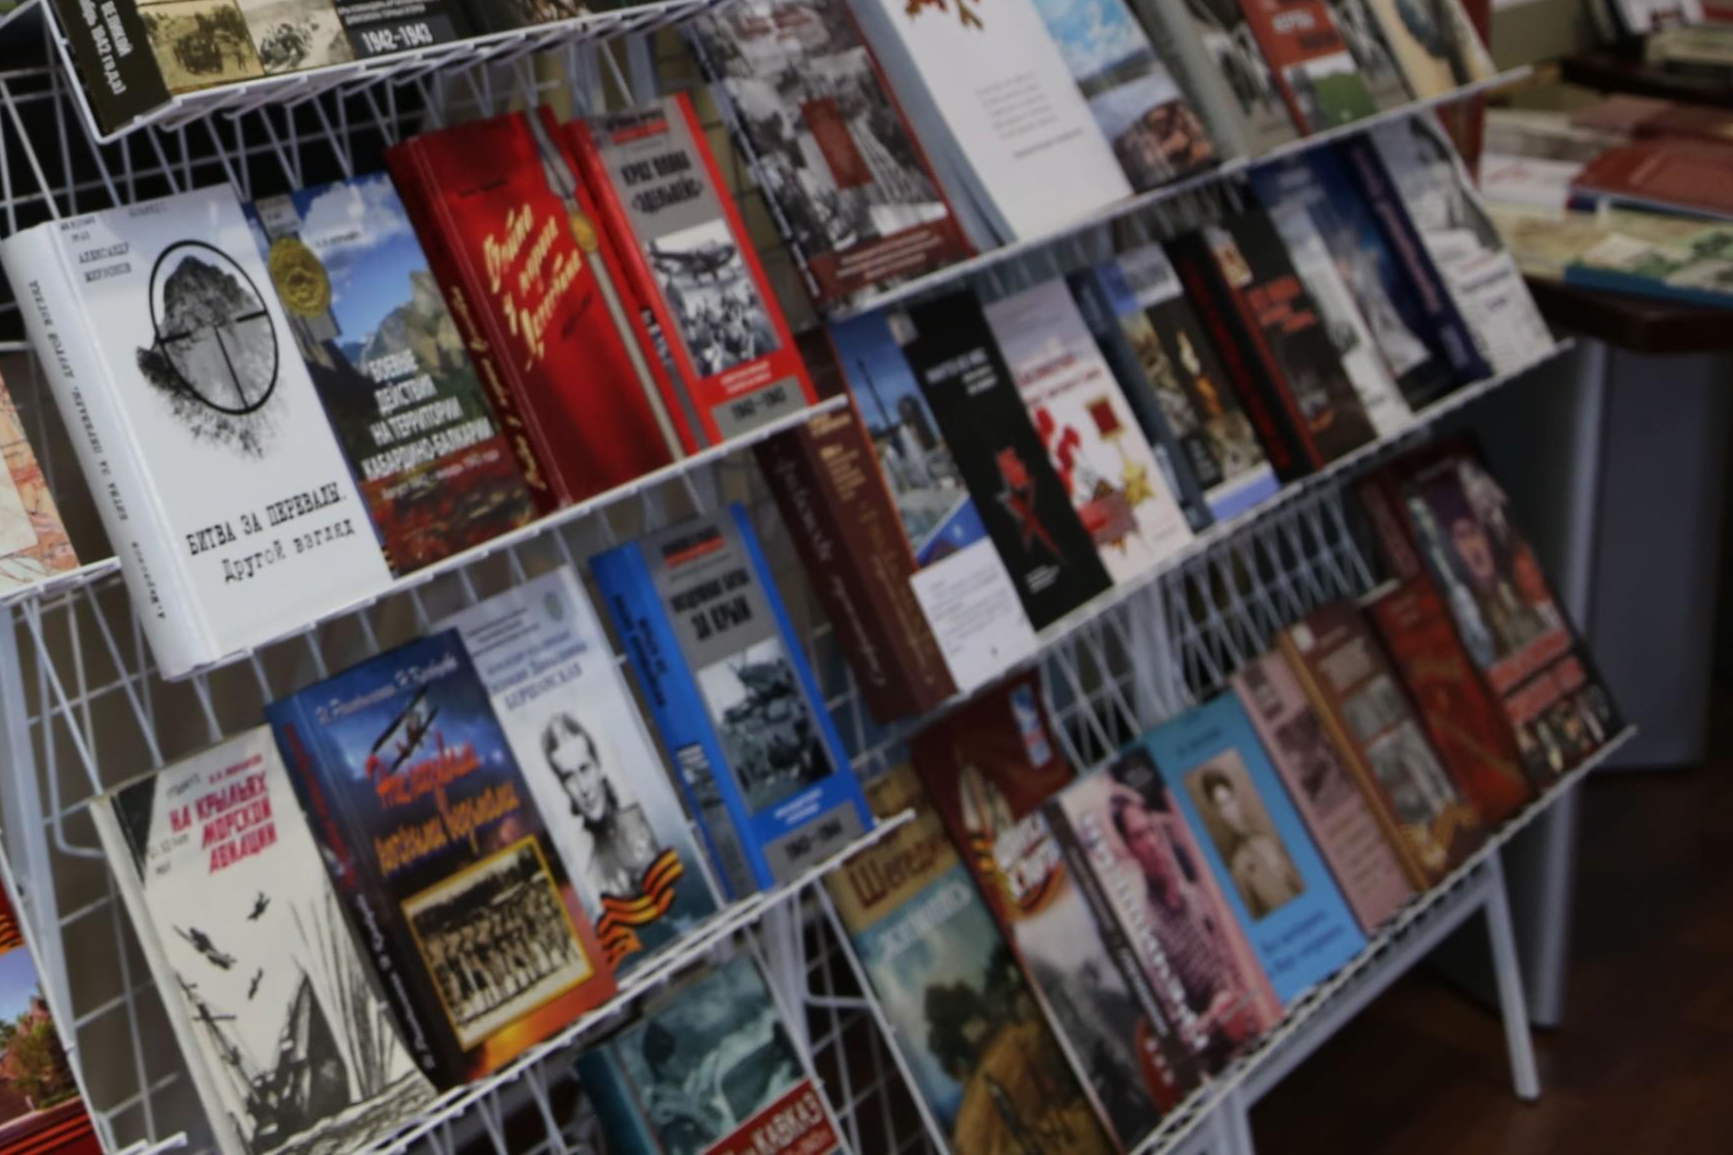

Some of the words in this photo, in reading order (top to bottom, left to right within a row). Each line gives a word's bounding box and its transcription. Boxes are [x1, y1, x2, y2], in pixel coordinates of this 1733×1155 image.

[185, 517, 237, 556] БИТВА
[239, 510, 264, 534] ЗА
[221, 541, 286, 584] Другой
[295, 518, 356, 555] взгляд
[168, 803, 193, 834] НА
[195, 771, 269, 822] КРЫЛЬЯХ
[201, 799, 274, 850] МОРСКОЙ
[208, 824, 279, 875] АВИАЦИИ
